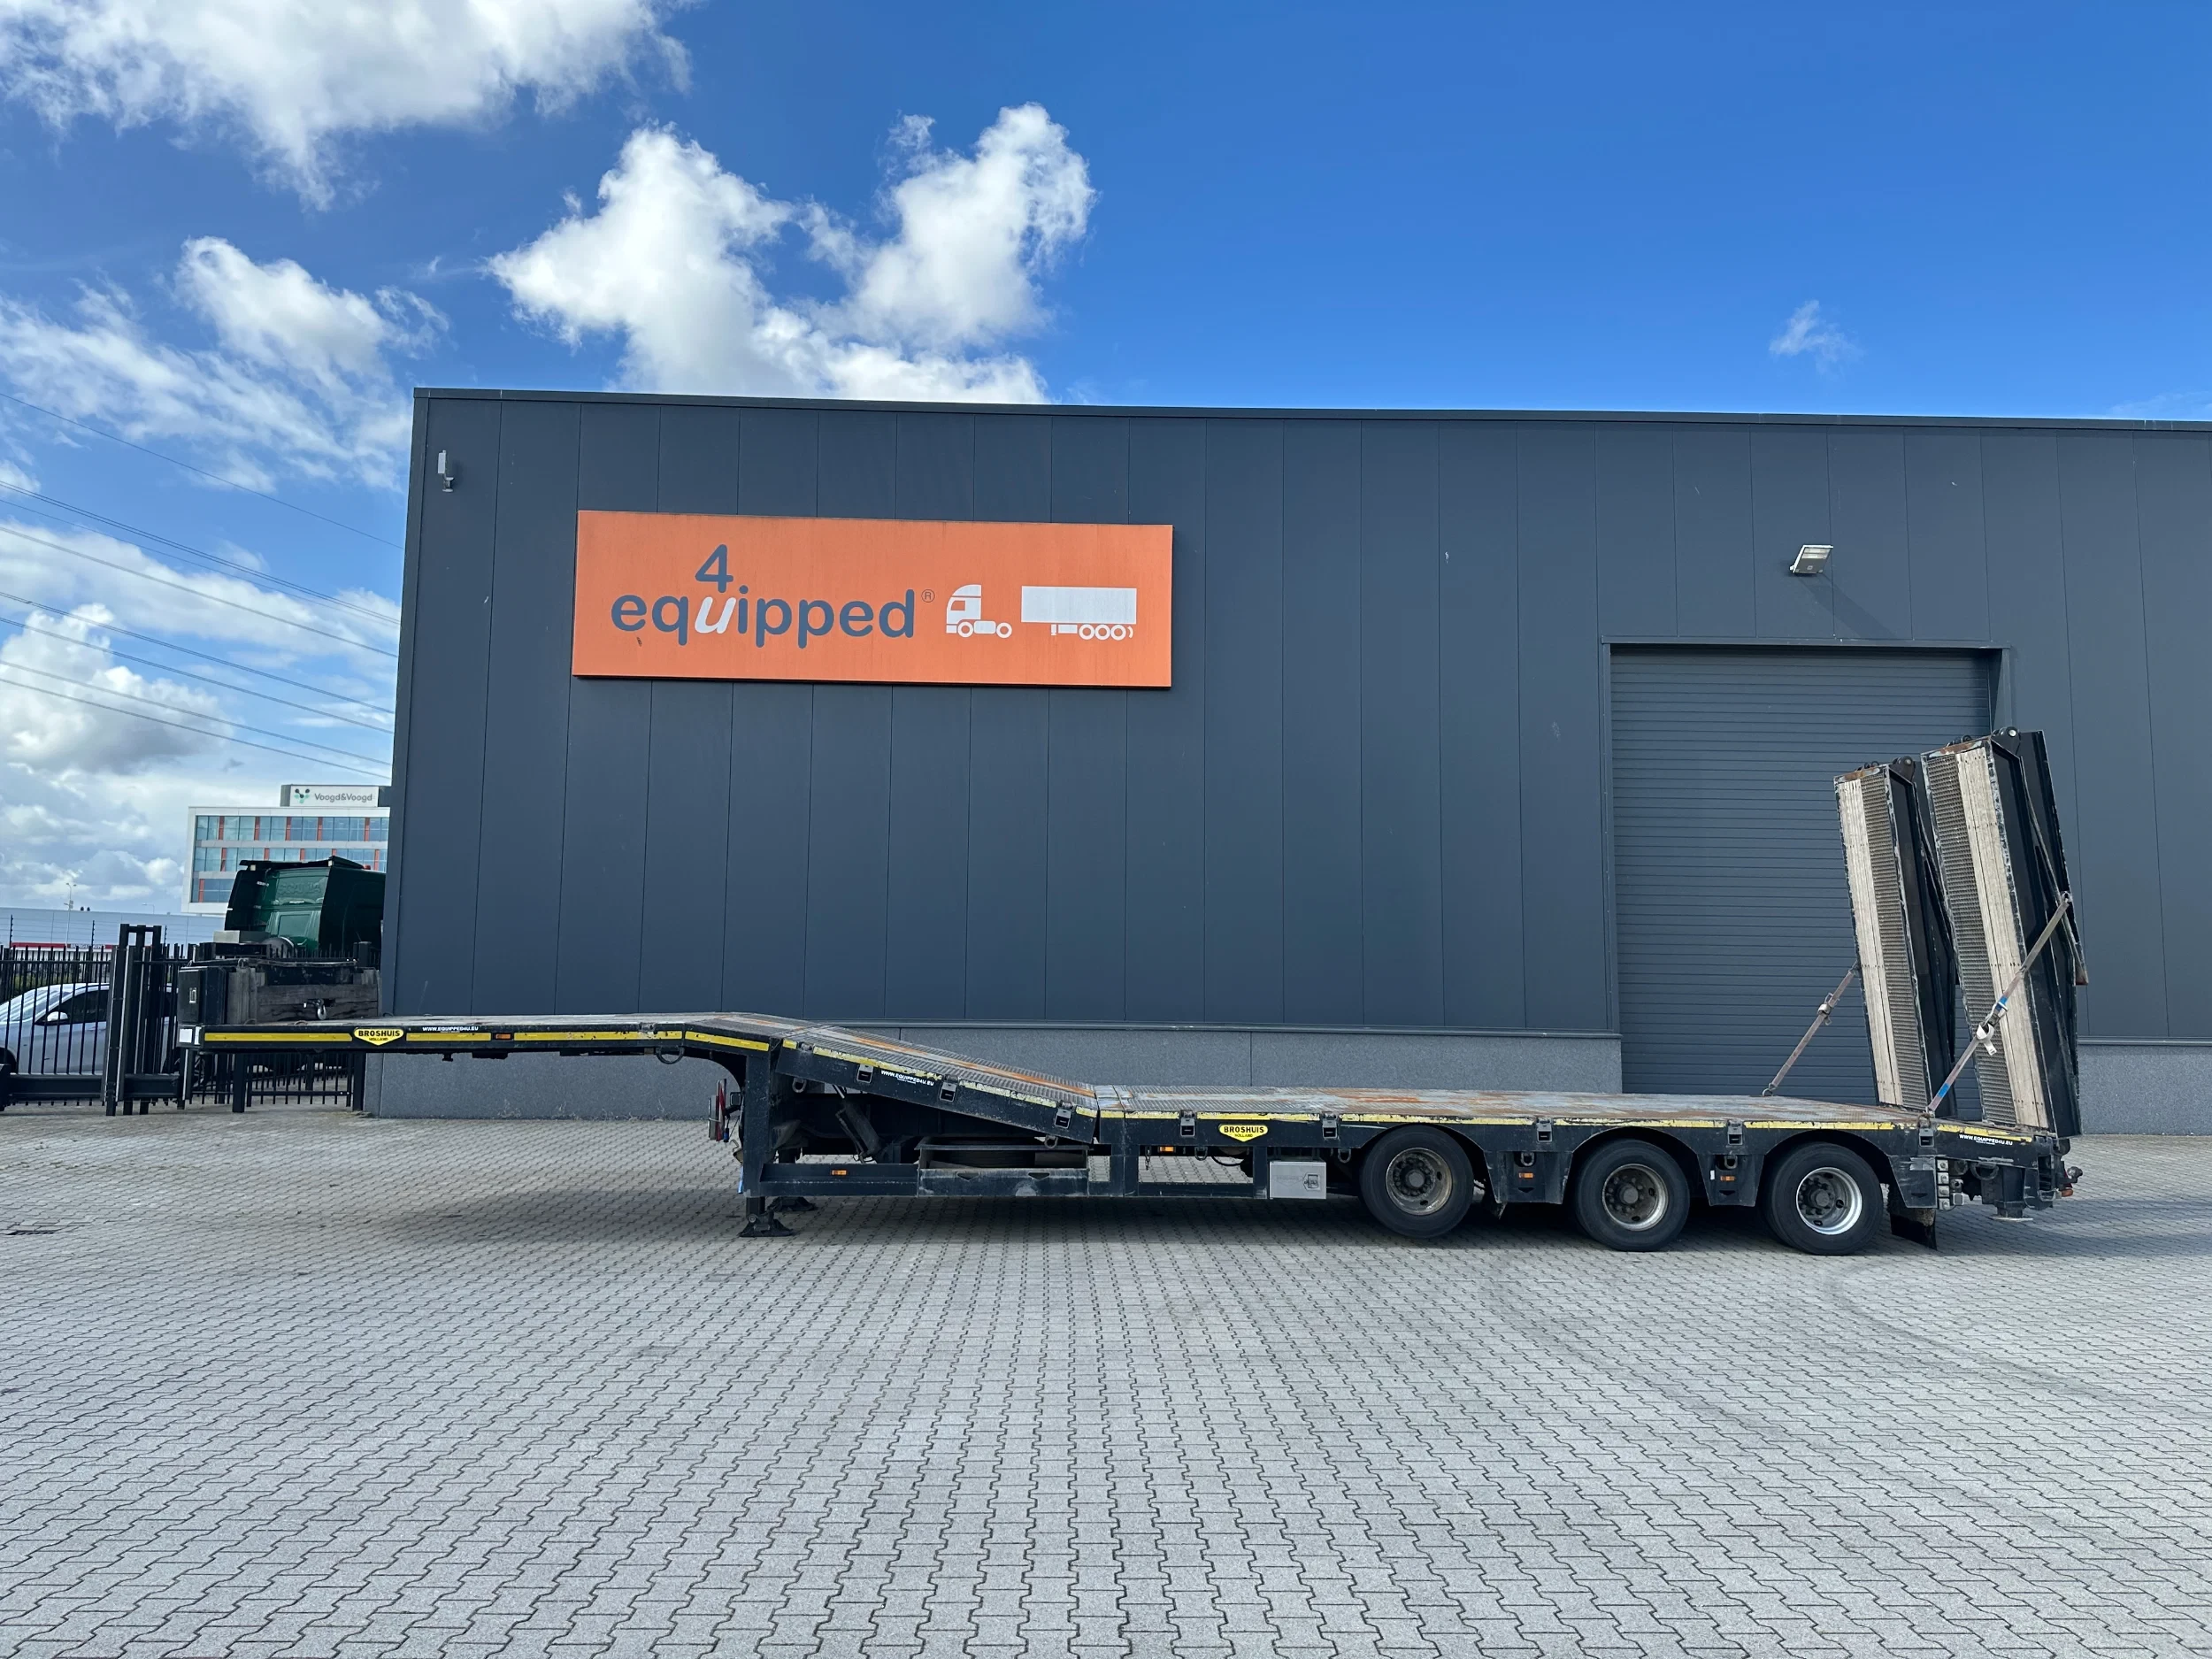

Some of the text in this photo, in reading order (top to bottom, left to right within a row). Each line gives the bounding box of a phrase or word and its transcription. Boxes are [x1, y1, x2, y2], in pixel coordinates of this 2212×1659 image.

[695, 543, 733, 594] 4
[611, 585, 915, 649] equipped
[314, 793, 373, 803] Voogd&Voogd
